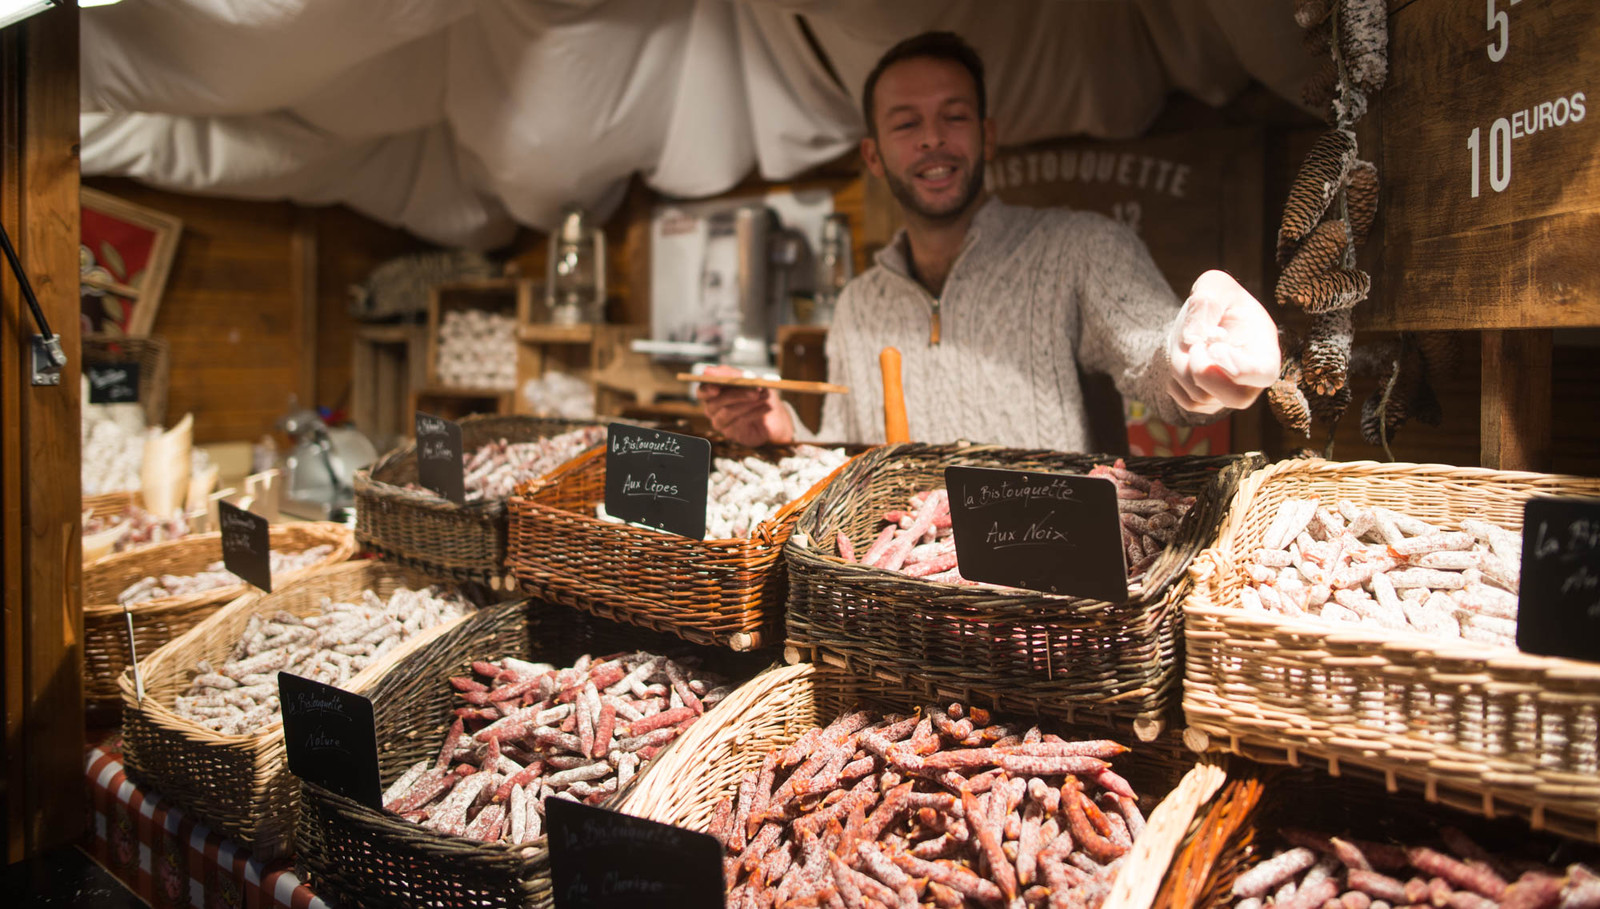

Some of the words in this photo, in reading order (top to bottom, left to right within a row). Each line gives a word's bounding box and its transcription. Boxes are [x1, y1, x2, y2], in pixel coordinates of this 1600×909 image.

[1467, 117, 1511, 198] 10
[1512, 92, 1586, 139] EUROS
[623, 473, 641, 494] Aux
[979, 479, 1075, 508] Bistouquette
[986, 520, 1017, 543] Aux
[1023, 510, 1068, 542] Noix
